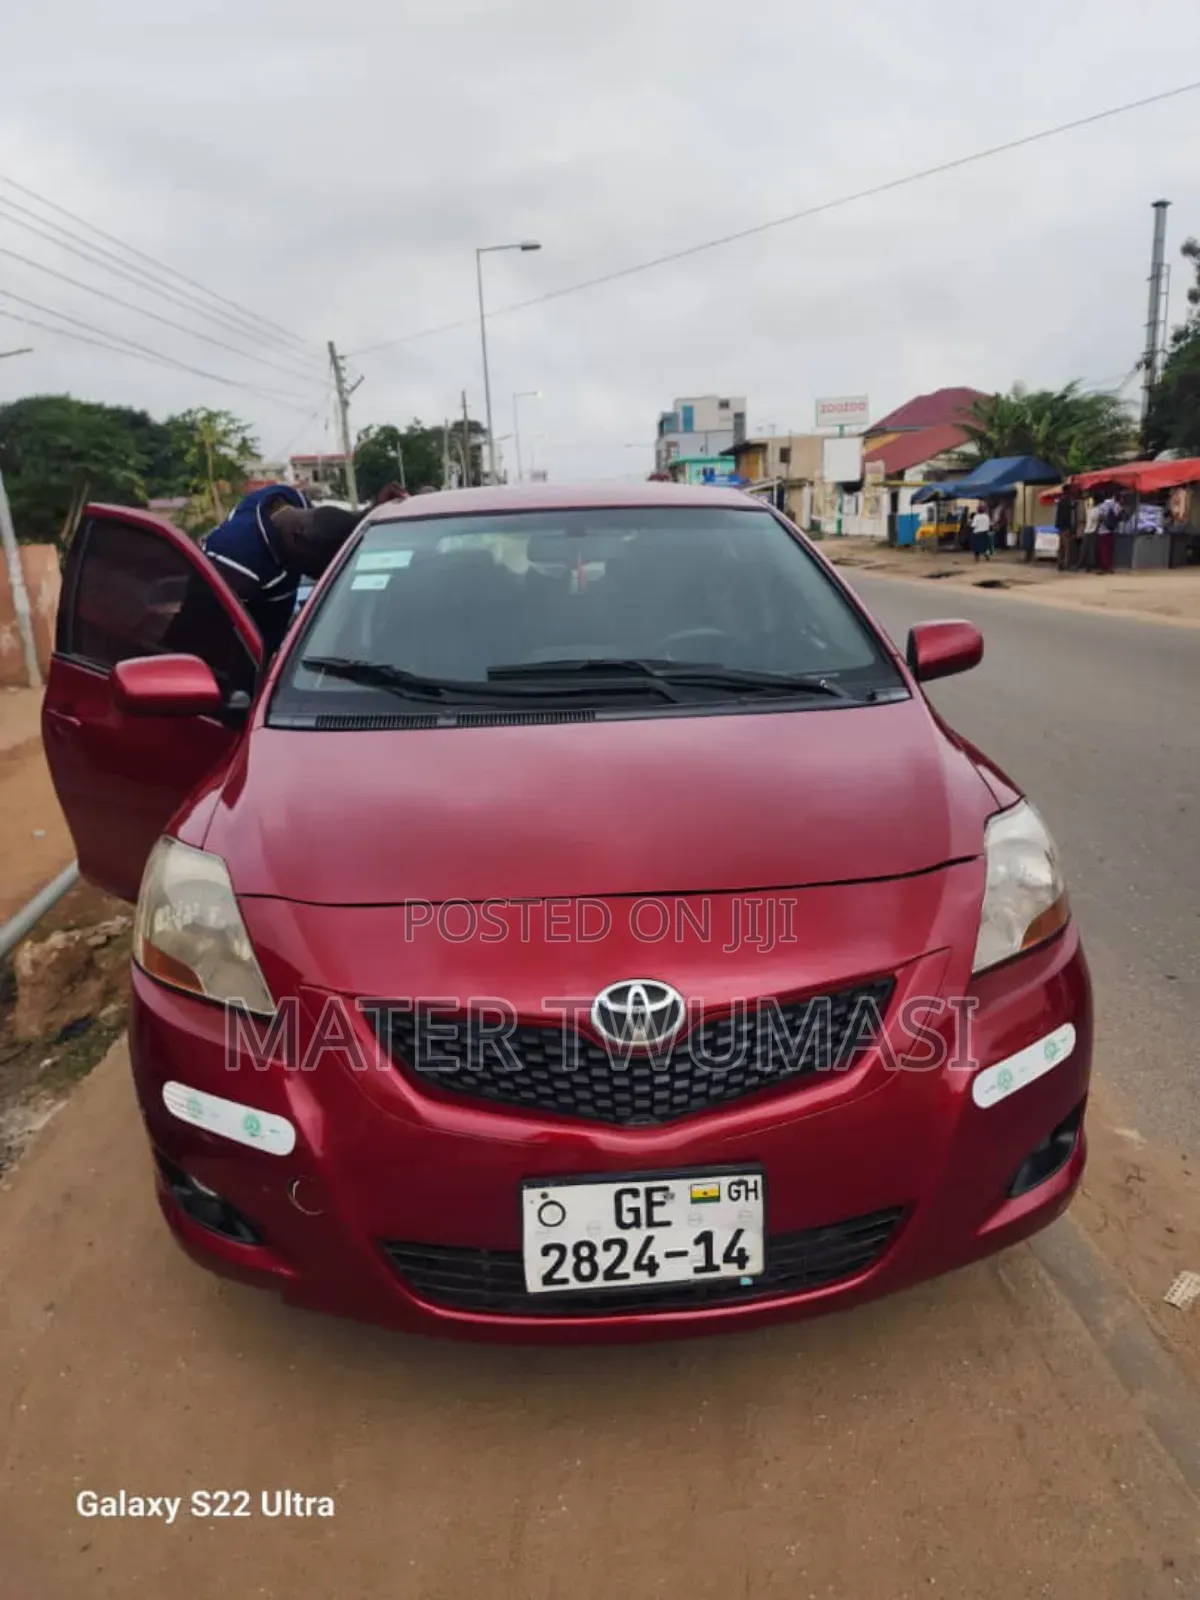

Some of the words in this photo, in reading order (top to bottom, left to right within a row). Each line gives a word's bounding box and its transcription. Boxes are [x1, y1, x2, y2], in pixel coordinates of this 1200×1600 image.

[614, 1186, 672, 1230] GE
[727, 1179, 759, 1202] GH
[540, 1228, 750, 1286] 2824-14
